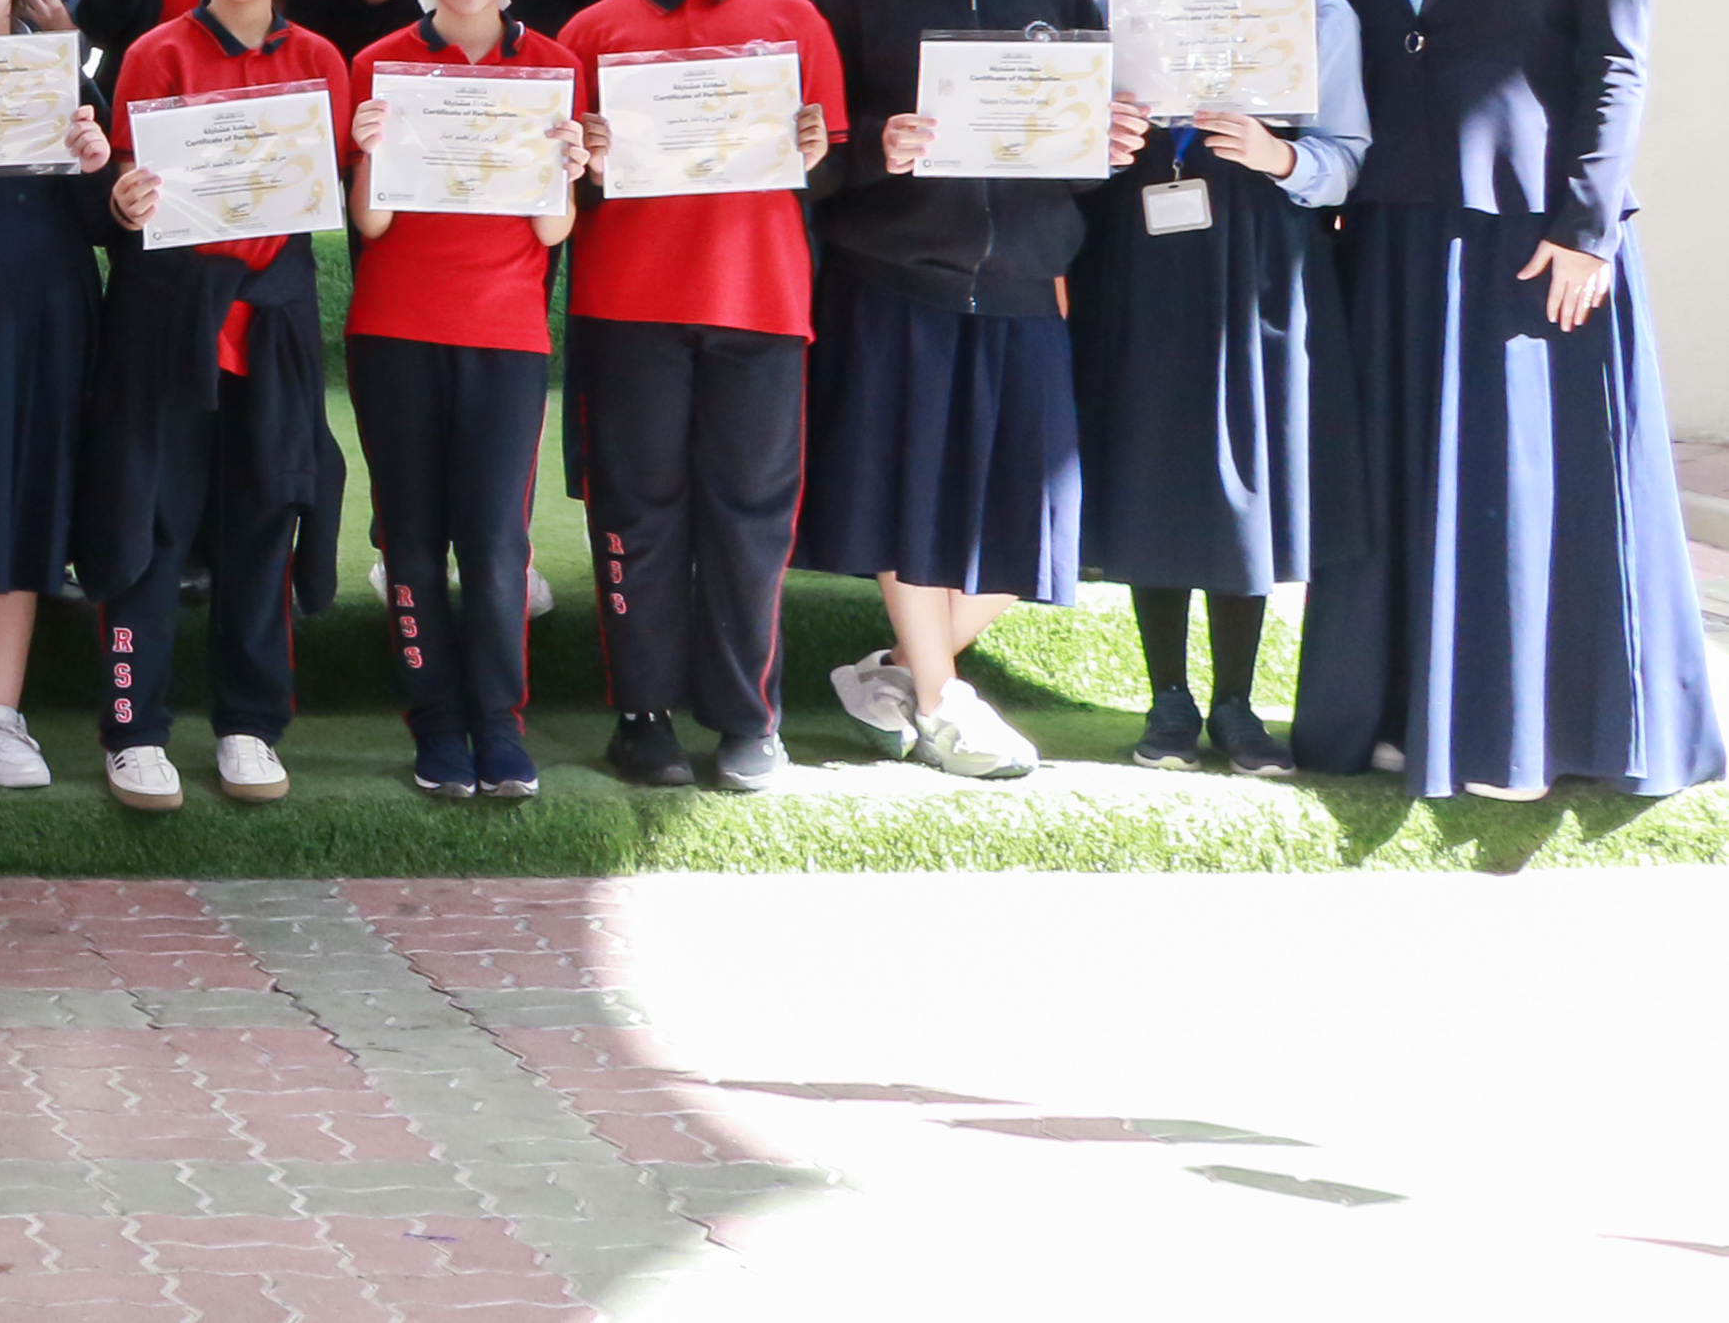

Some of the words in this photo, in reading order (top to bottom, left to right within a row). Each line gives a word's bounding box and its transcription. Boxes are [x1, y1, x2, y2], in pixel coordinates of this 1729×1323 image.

[606, 532, 626, 615] RSS
[394, 584, 422, 668] RSS
[112, 626, 134, 723] RSS
